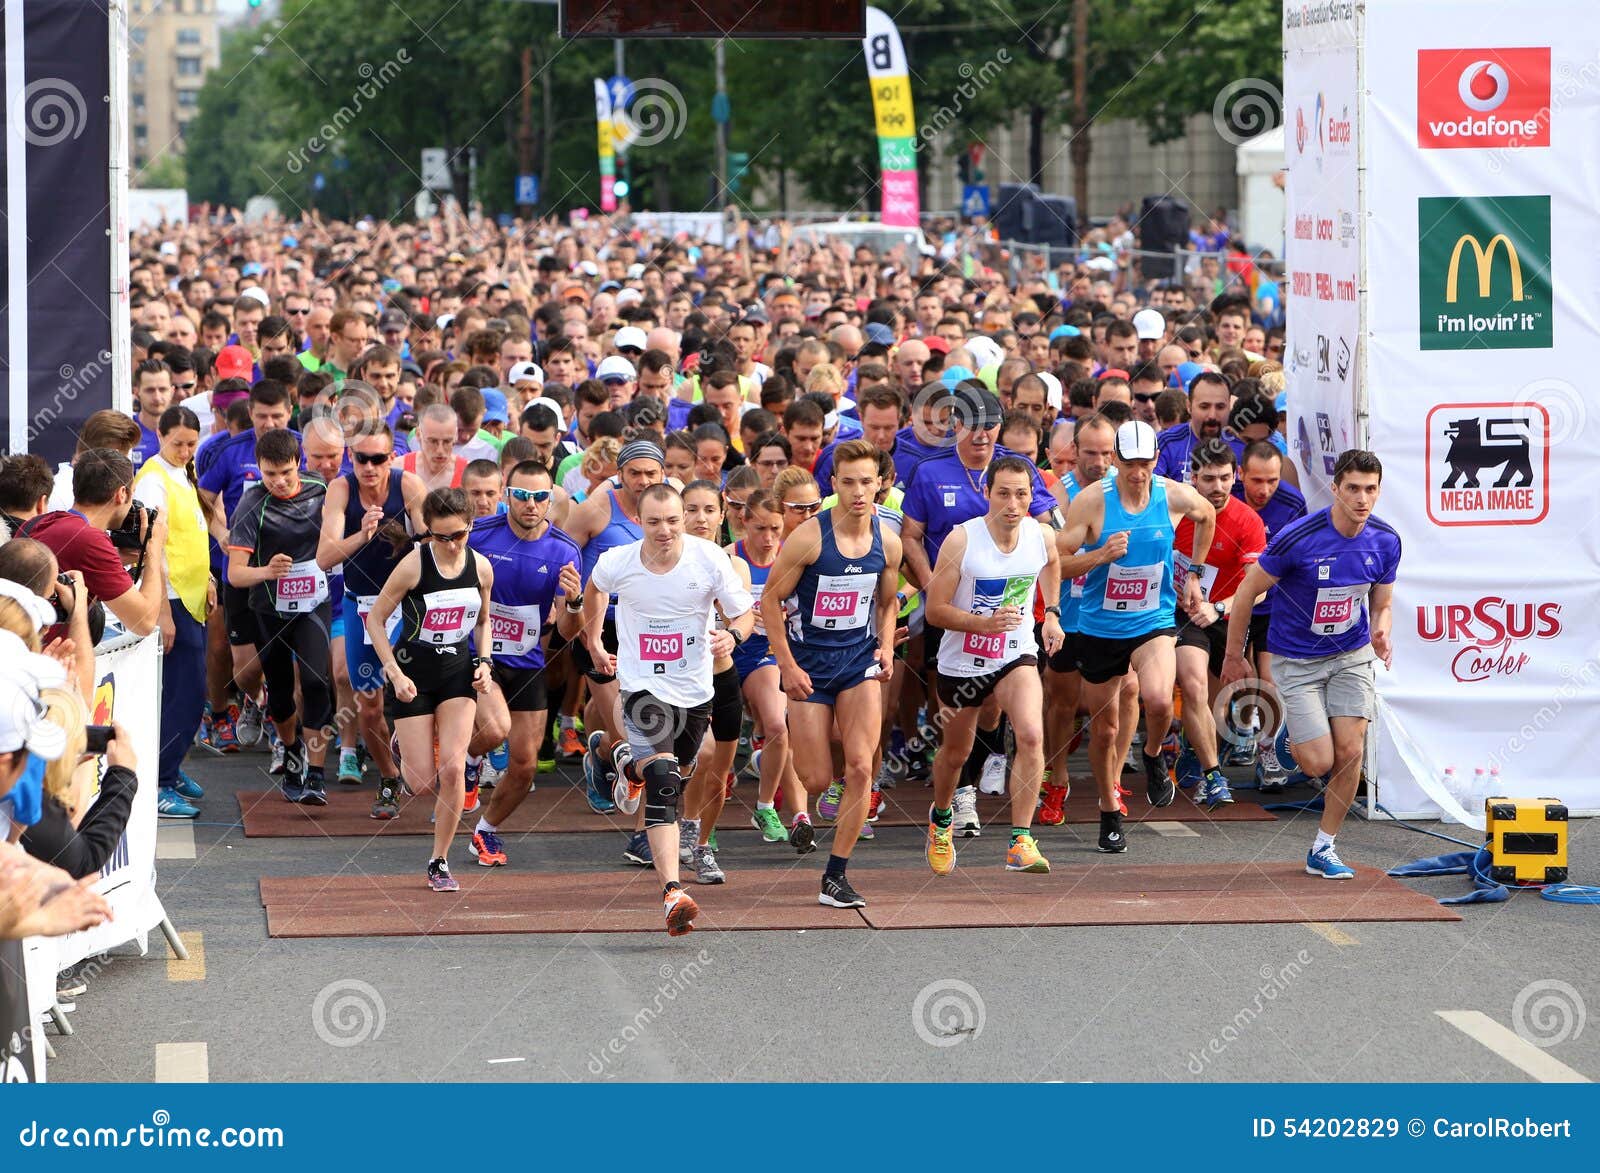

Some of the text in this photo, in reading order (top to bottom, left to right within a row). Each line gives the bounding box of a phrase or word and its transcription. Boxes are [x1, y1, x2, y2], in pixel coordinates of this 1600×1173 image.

[1428, 116, 1537, 137] vodafone
[1441, 489, 1534, 511] MEGA IMAGE
[282, 579, 311, 594] 8325
[1111, 582, 1143, 595] 7058
[821, 595, 852, 611] 9631
[430, 610, 459, 626] 9812
[1416, 597, 1562, 646] URSUS
[644, 637, 679, 654] 7050
[969, 634, 1001, 652] 8718
[1451, 638, 1531, 682] Cooler
